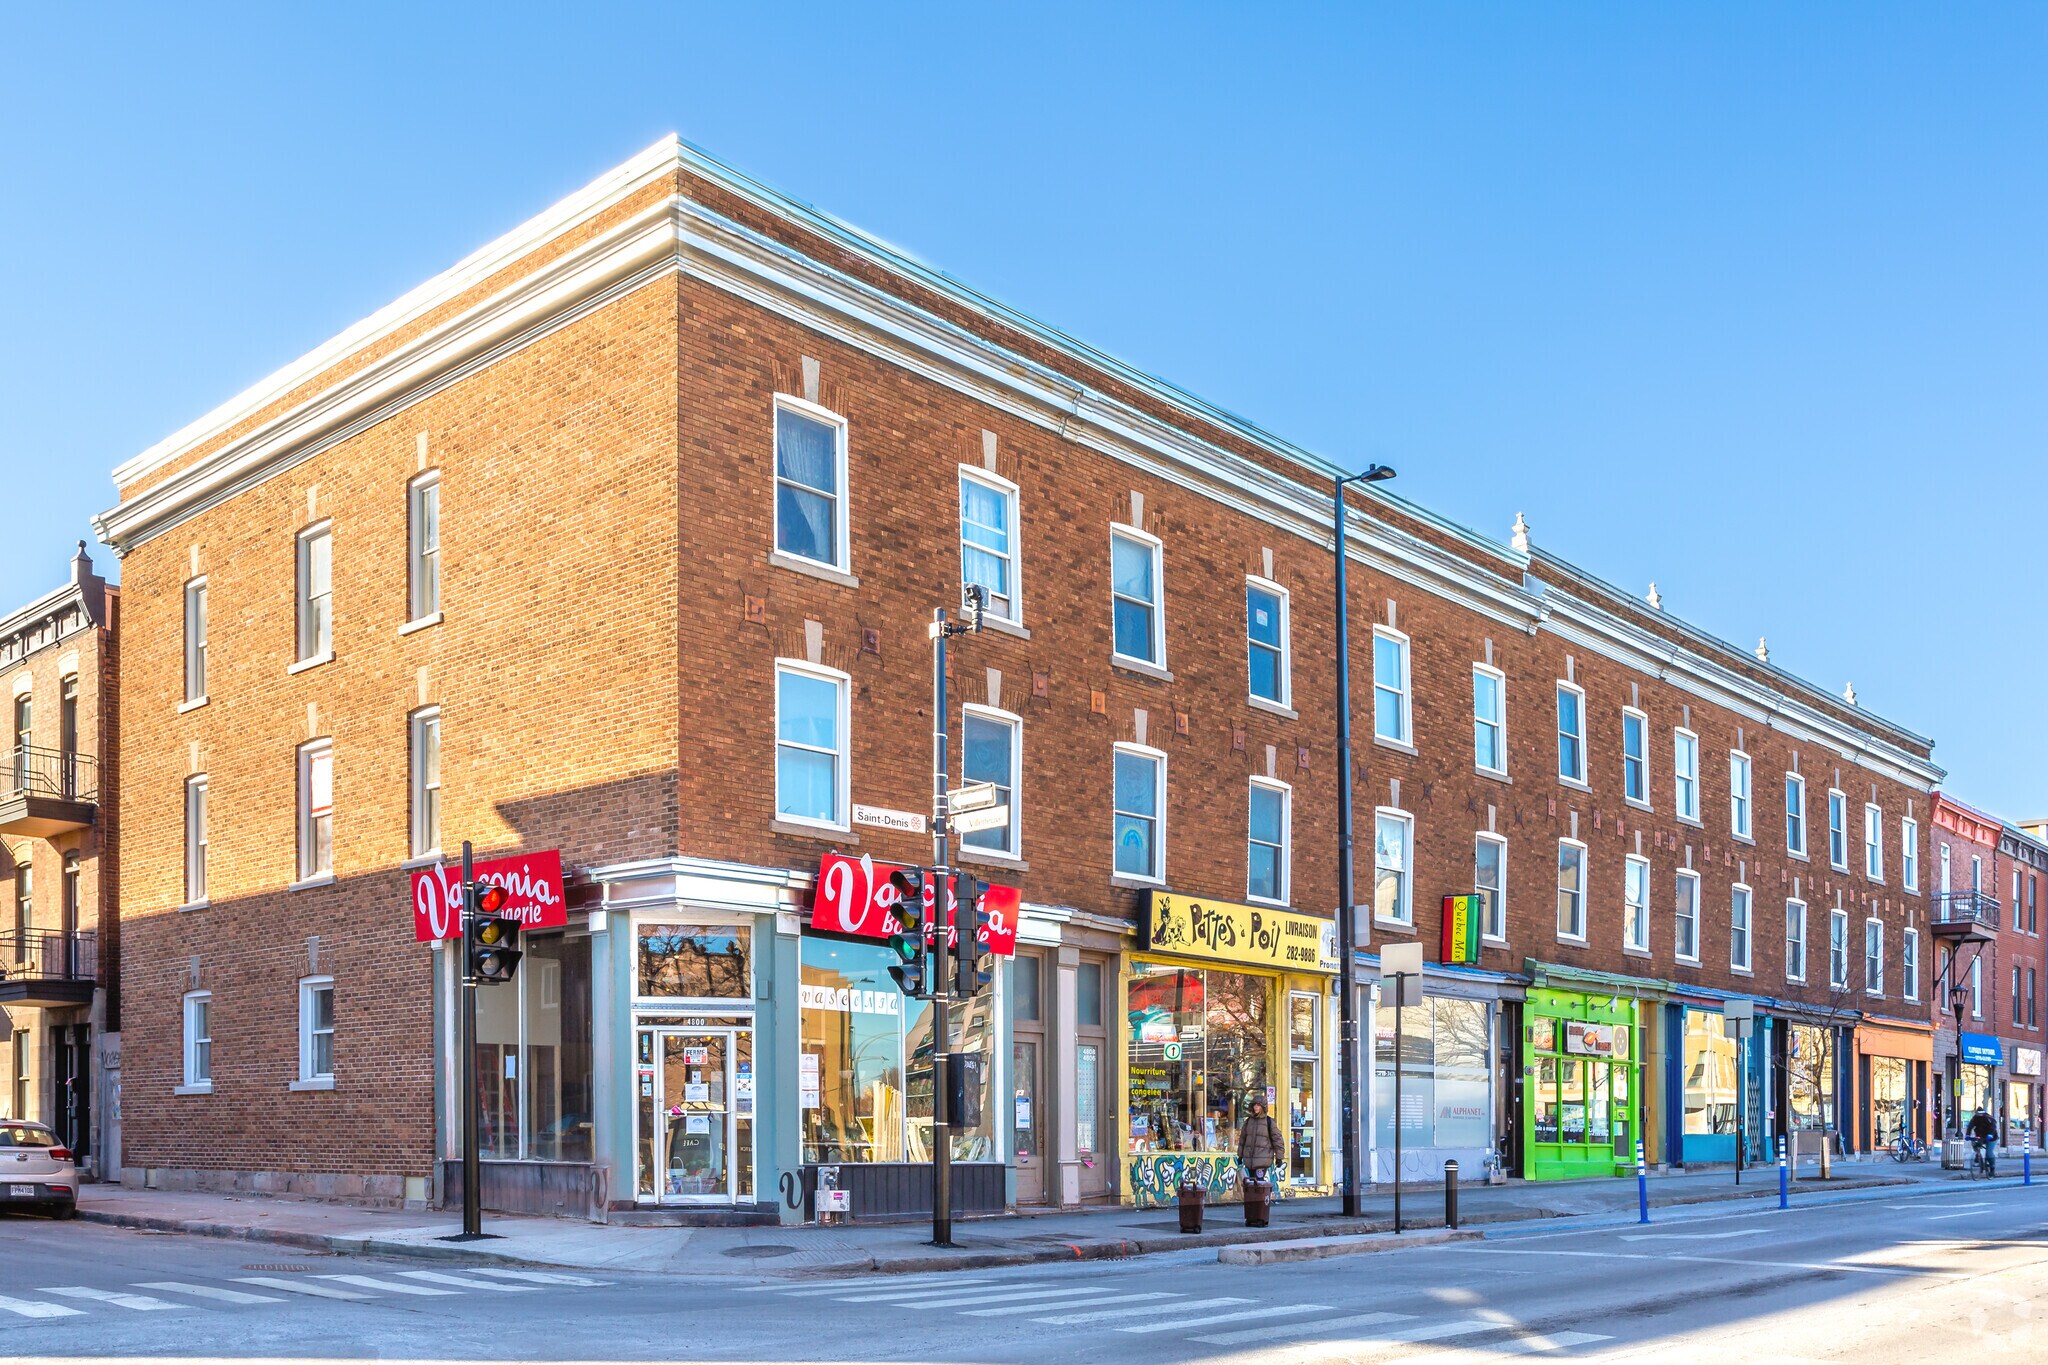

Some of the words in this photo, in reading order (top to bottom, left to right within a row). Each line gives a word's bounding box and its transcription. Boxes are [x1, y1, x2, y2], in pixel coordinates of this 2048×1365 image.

[857, 811, 909, 828] Saint-Denis
[1189, 903, 1236, 951] Pattes
[1249, 912, 1281, 957] Poil
[1285, 920, 1318, 939] LIVRAISON
[1455, 939, 1464, 960] Mix
[1131, 1067, 1166, 1076] Nourriture
[1453, 1107, 1481, 1116] ALPHANET
